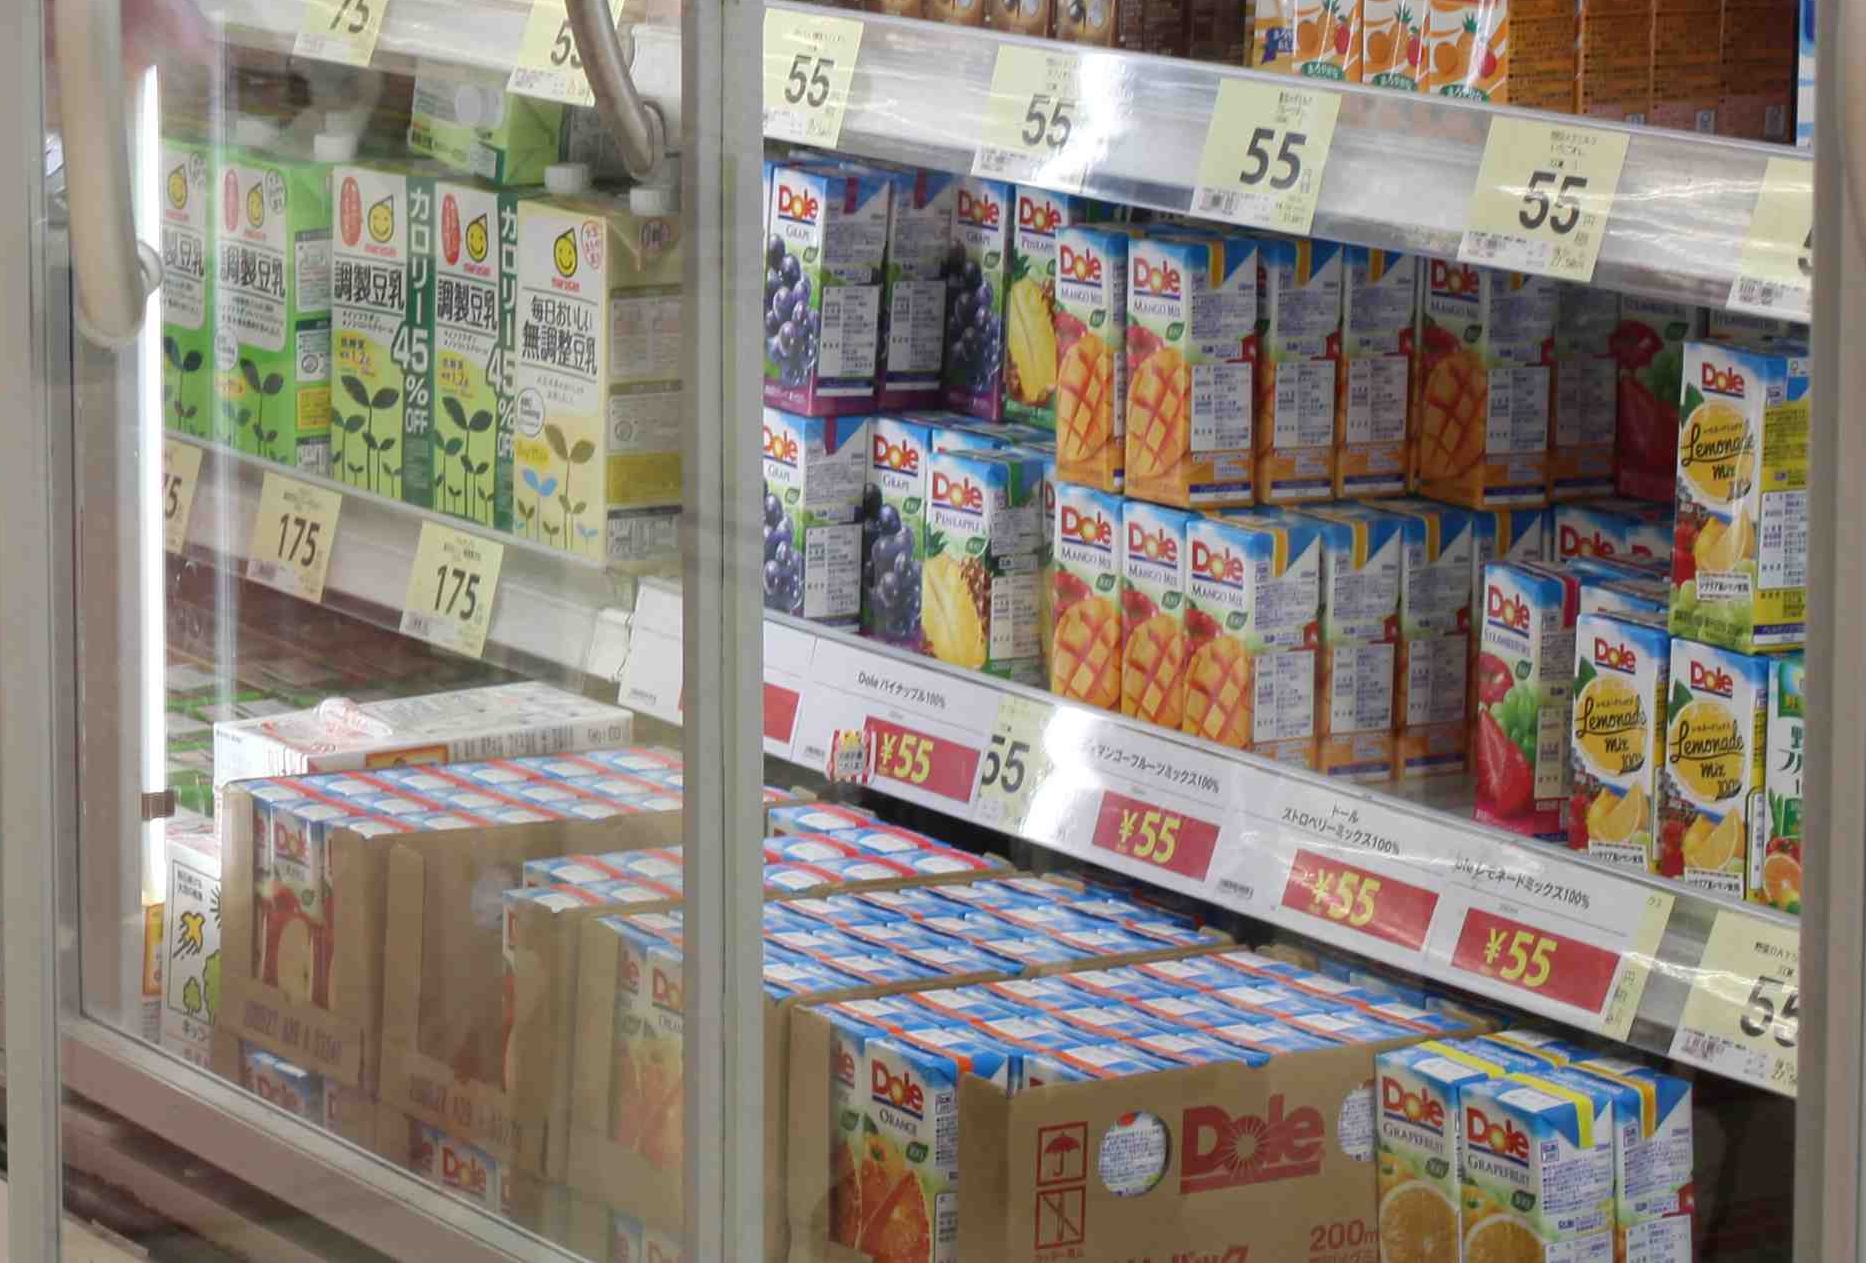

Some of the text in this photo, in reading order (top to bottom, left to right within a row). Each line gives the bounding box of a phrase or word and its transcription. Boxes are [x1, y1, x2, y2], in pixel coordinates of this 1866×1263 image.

[785, 55, 834, 108] 55
[1021, 94, 1076, 148] 55
[1239, 128, 1307, 190] 55
[778, 185, 819, 219] Dole
[958, 190, 999, 225] Dole
[1020, 197, 1062, 233] Dole
[1518, 172, 1587, 234] 55
[1061, 245, 1101, 282] Dole
[1134, 257, 1180, 294] Dole
[334, 264, 405, 309] 調製豆乳
[437, 280, 497, 330] 調製豆乳
[531, 294, 593, 330] 毎日おいしい
[522, 321, 597, 375] 無調整豆乳
[1702, 361, 1744, 393] Dole
[873, 434, 919, 472] Dole
[933, 472, 982, 510] Dole
[278, 514, 320, 567] 175
[1061, 506, 1112, 545] Dole
[1128, 521, 1177, 562] Dole
[1192, 540, 1244, 583] Dole
[434, 565, 480, 621] 175
[1488, 585, 1530, 629] Dole
[1595, 638, 1636, 672] Dole
[1690, 661, 1733, 695] Dole
[1670, 721, 1744, 763] Lemonade
[982, 735, 1030, 793] 55
[871, 1058, 923, 1111] Dole
[1382, 1076, 1444, 1127] Dole
[1181, 1095, 1325, 1179] Dole
[1467, 1106, 1529, 1159] Dole
